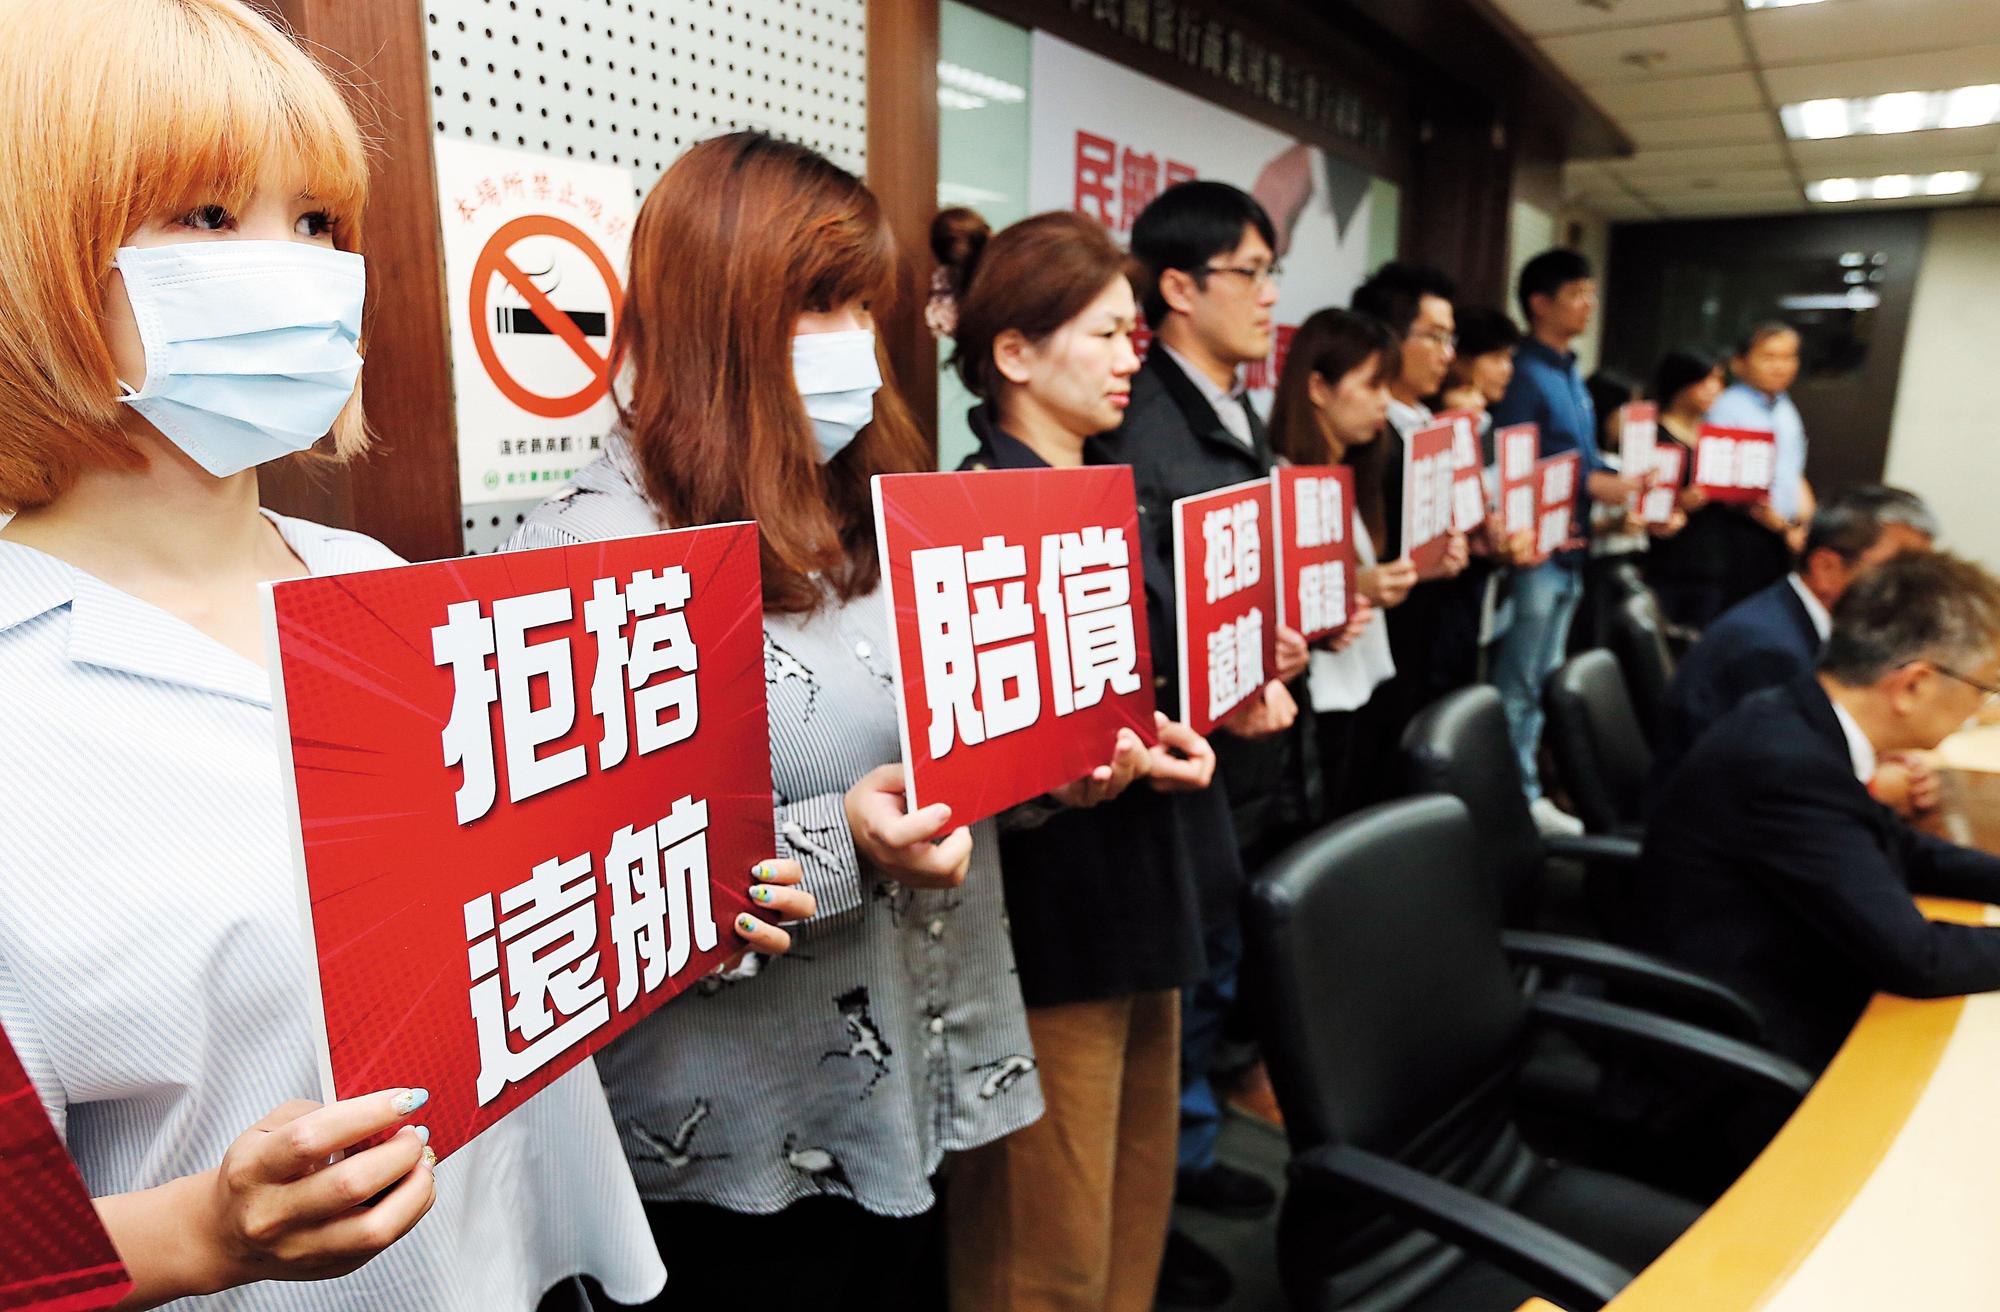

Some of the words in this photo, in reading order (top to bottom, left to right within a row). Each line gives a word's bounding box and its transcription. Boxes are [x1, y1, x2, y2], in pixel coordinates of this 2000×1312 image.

[911, 526, 1141, 759] 賠償
[1203, 499, 1261, 604] 拒搭
[1207, 607, 1264, 720] 遠航
[431, 565, 700, 826] 拒搭
[463, 795, 718, 1108] 遠航
